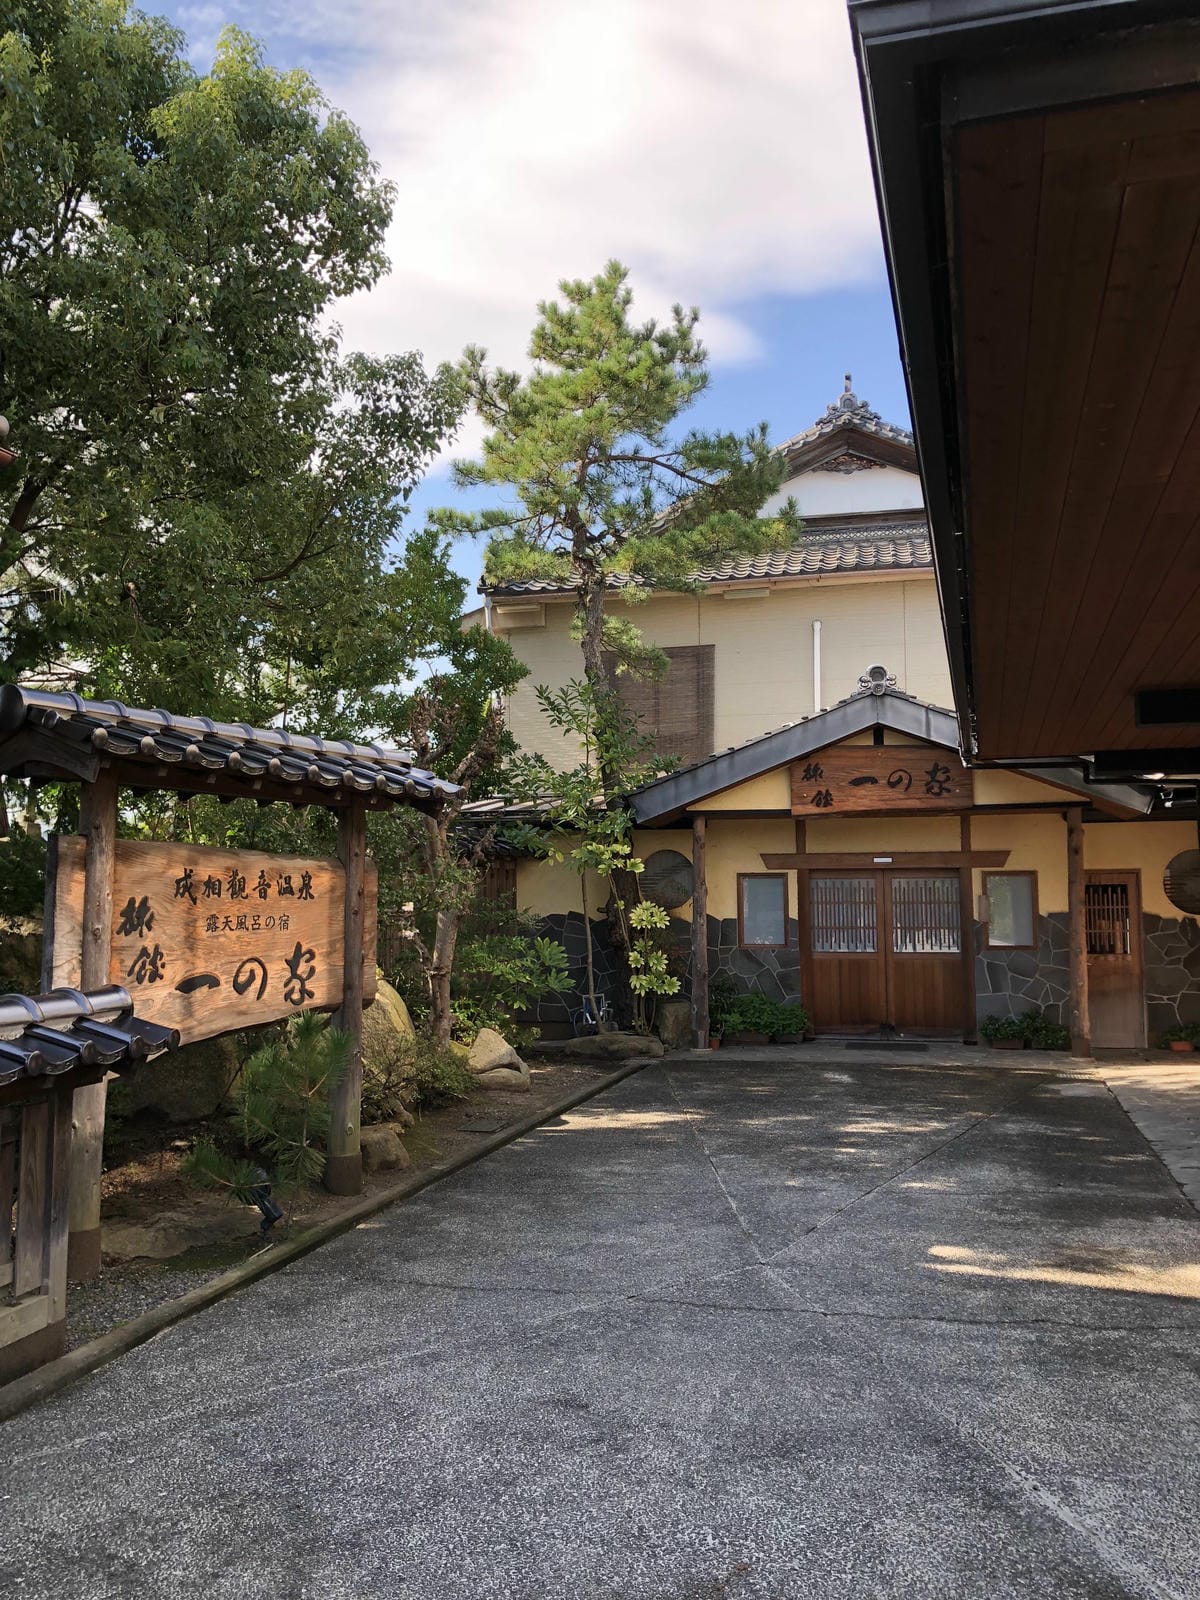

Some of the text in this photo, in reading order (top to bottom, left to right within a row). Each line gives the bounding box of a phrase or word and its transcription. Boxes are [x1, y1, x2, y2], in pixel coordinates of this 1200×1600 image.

[206, 914, 289, 932] 露天風呂の宿
